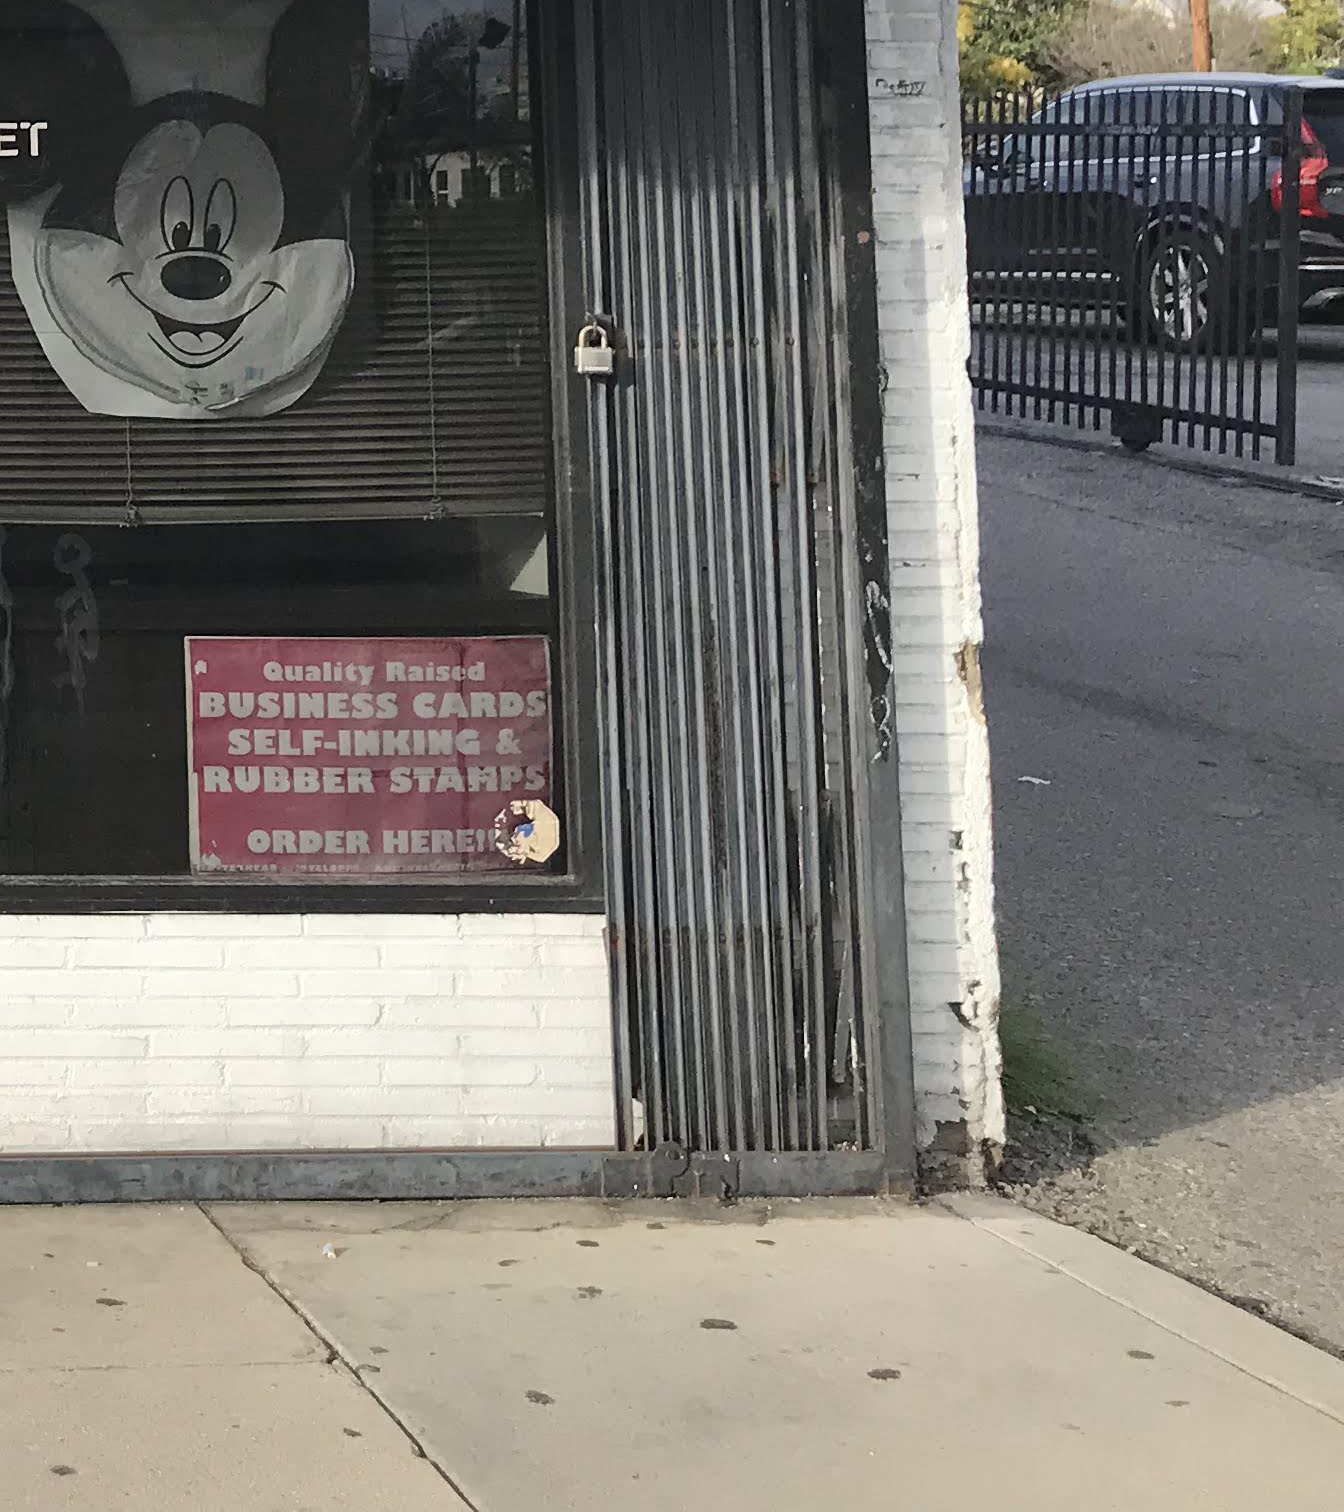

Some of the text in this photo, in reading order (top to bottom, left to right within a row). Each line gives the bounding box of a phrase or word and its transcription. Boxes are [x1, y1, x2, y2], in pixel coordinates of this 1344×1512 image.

[262, 660, 486, 688] Quality Raised
[199, 690, 547, 719] BUSINESS CARDS
[227, 727, 523, 756] SELF-INKING &
[203, 764, 547, 794] RUBBER STAMPS
[246, 829, 371, 855] ORDER
